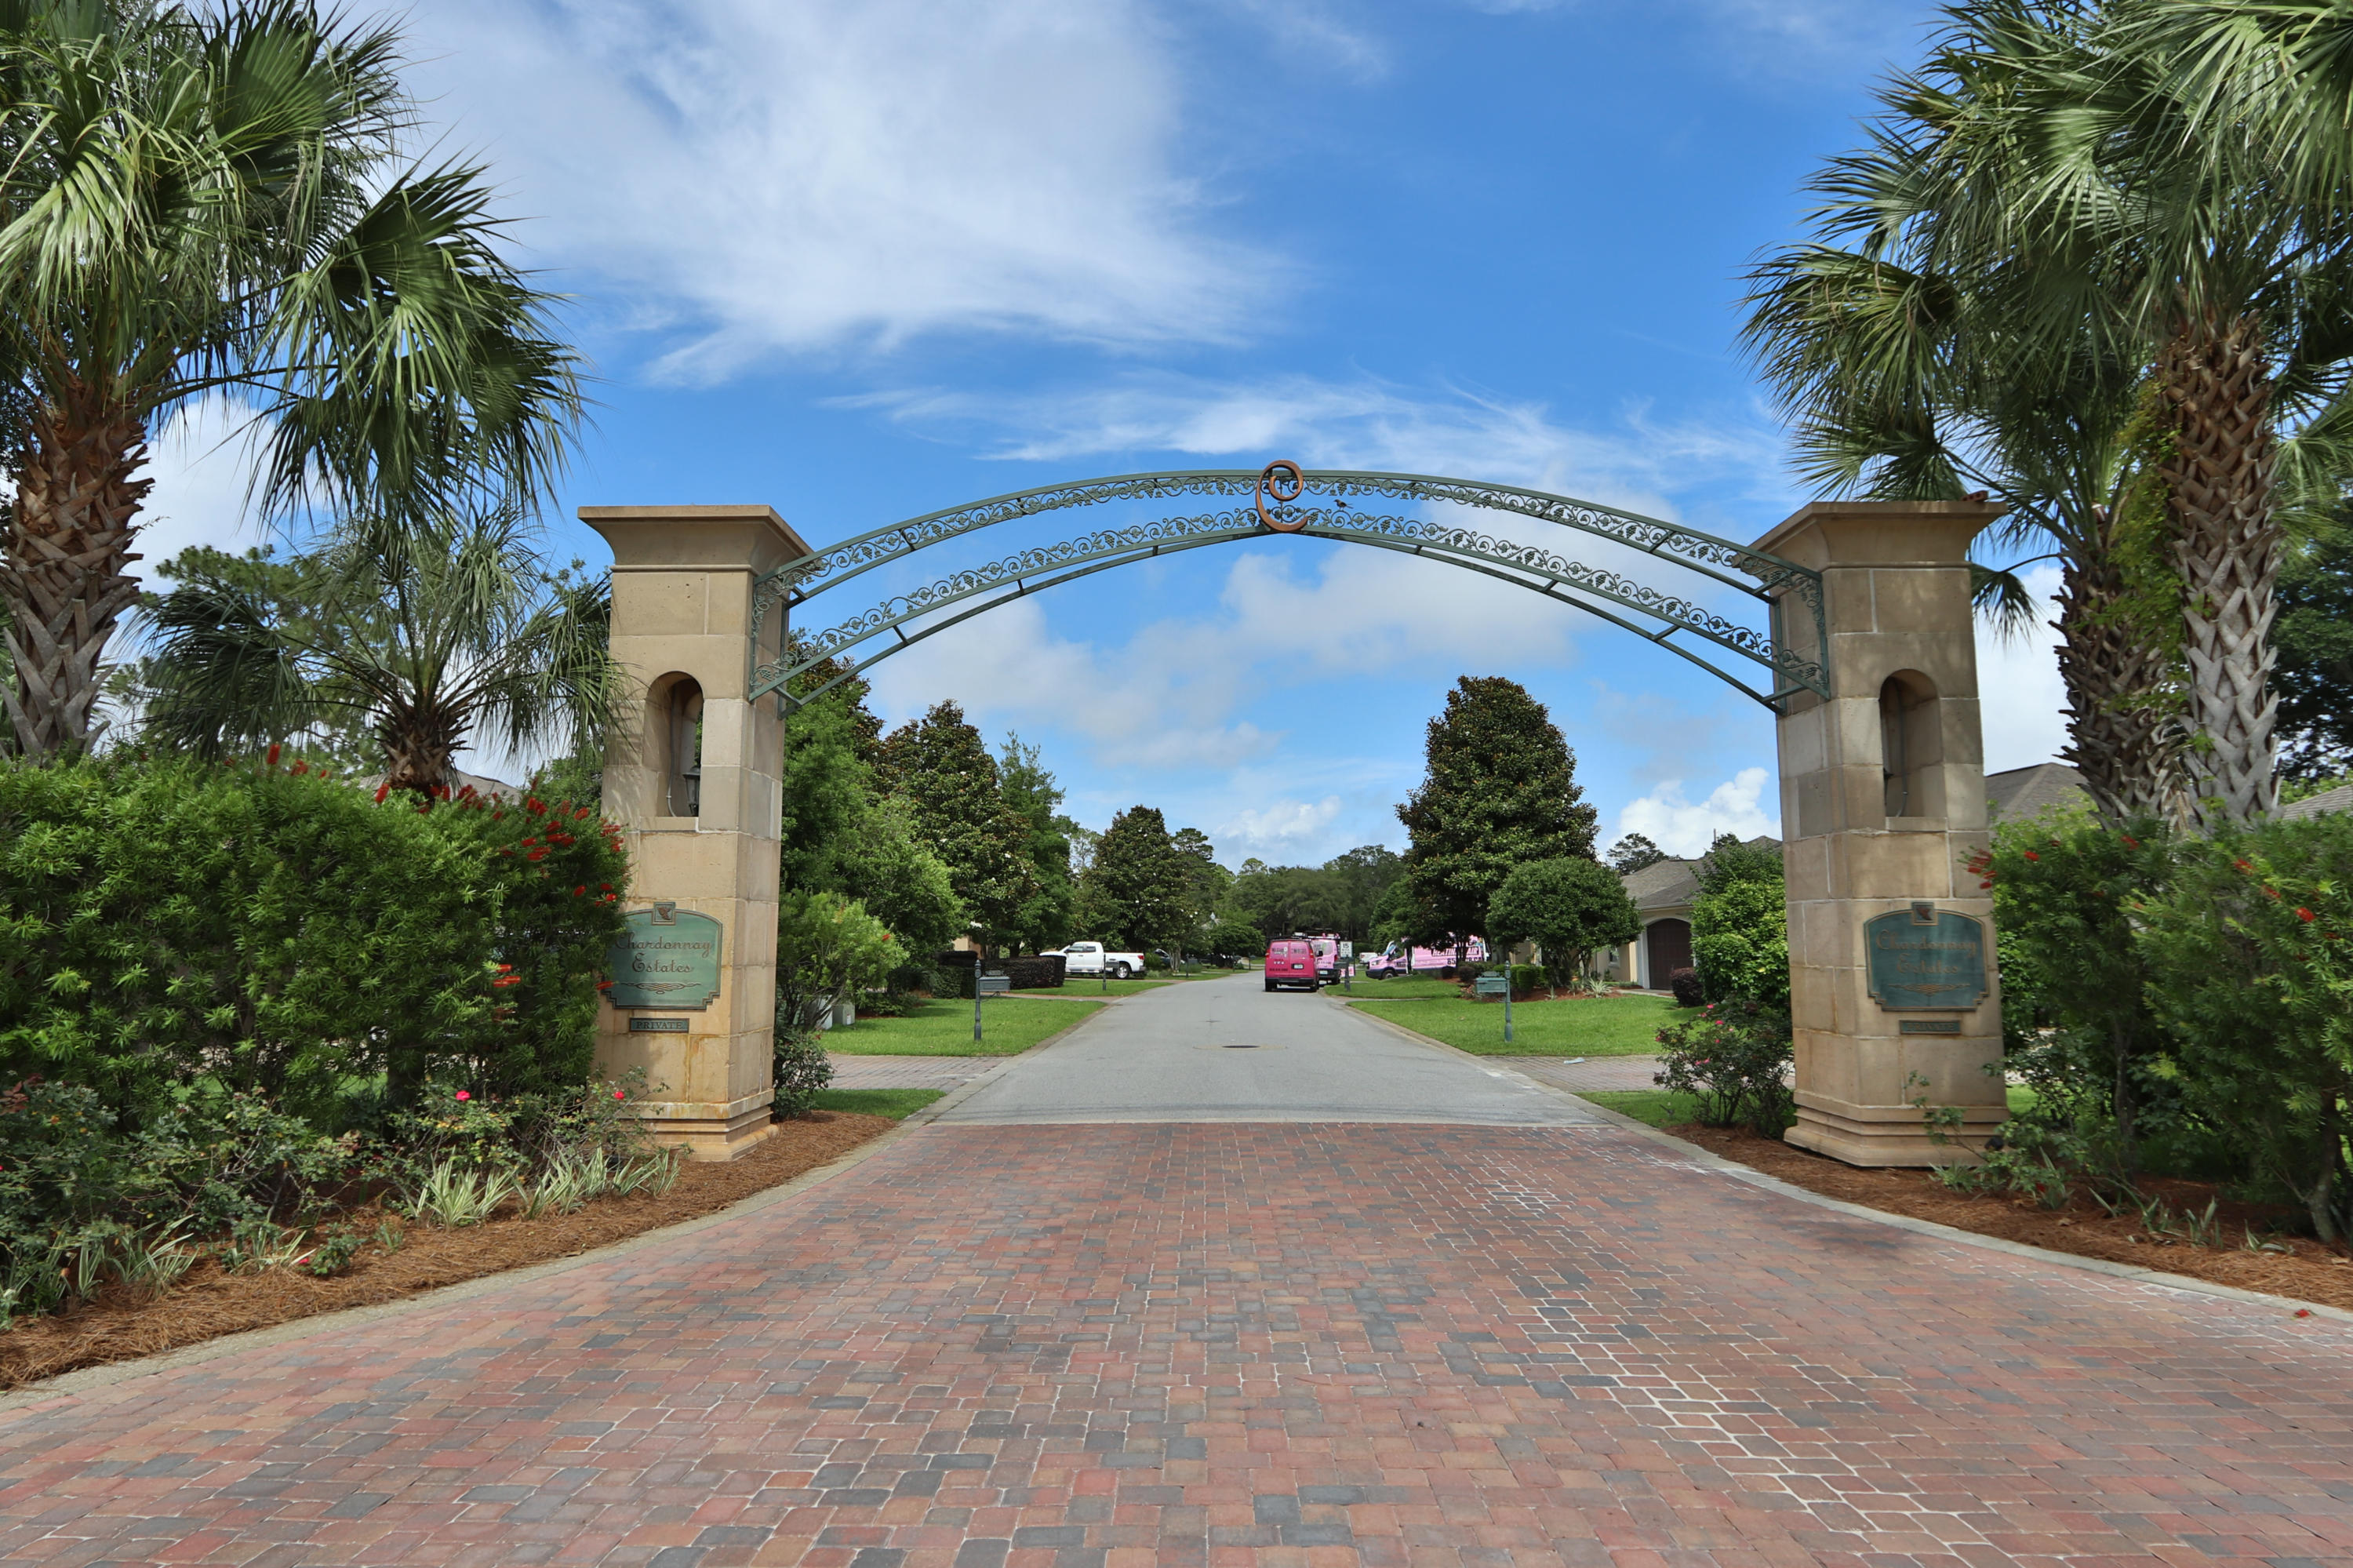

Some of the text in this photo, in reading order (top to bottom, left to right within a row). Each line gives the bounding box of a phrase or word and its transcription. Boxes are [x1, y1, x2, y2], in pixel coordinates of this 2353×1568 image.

[615, 931, 712, 958] Chardonnay
[1875, 929, 1977, 959] Chardonnay
[631, 952, 694, 973] Estates
[1897, 952, 1960, 974] Estates
[635, 1021, 683, 1030] PRIVATE
[1907, 1023, 1955, 1031] PRIVATE
